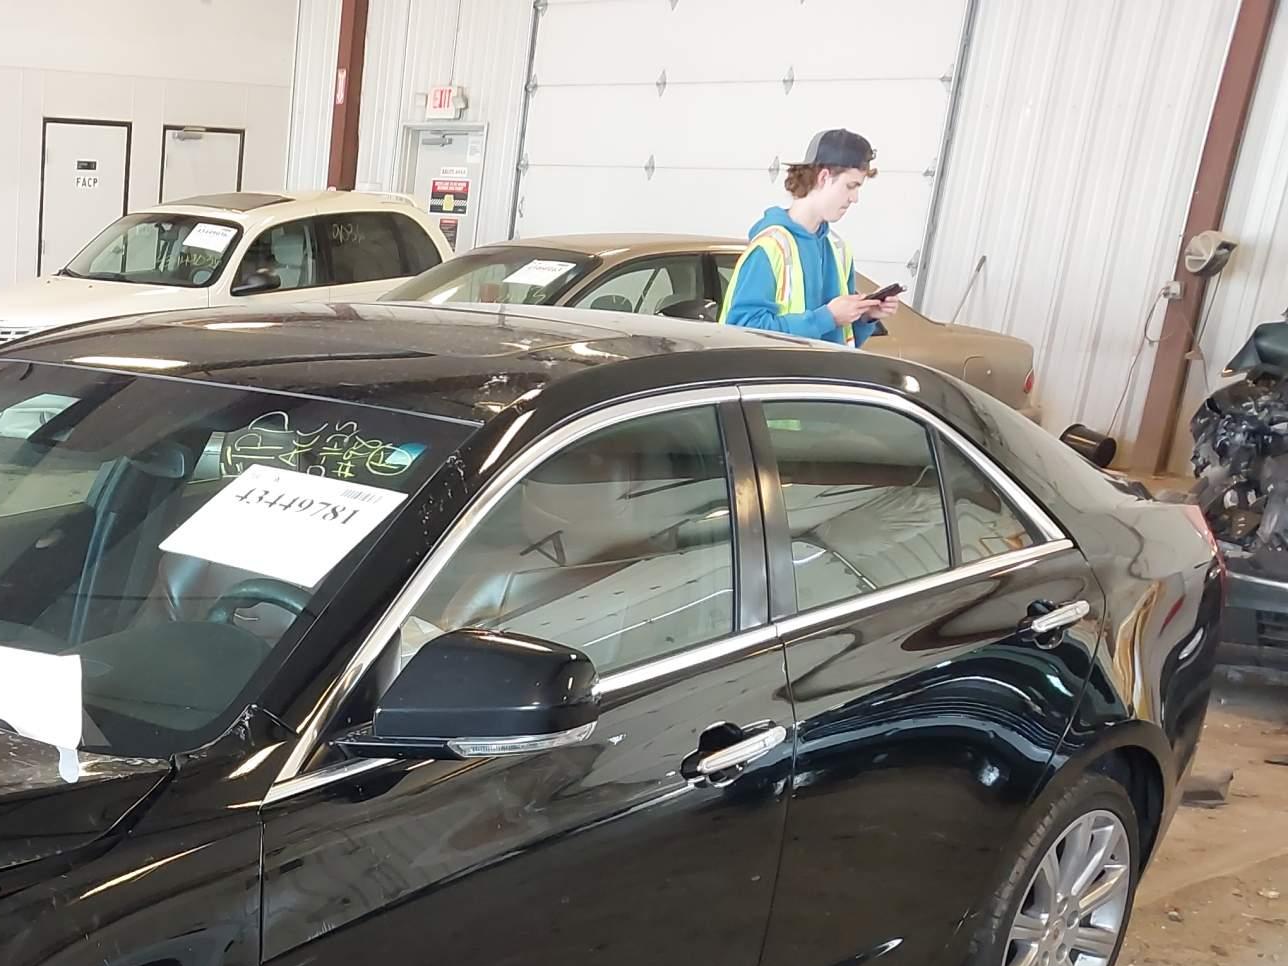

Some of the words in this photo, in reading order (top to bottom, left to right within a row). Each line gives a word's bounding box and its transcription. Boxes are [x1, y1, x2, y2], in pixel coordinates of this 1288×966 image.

[432, 88, 452, 109] EXIT
[76, 177, 98, 187] FACP
[235, 487, 360, 525] 43449781
